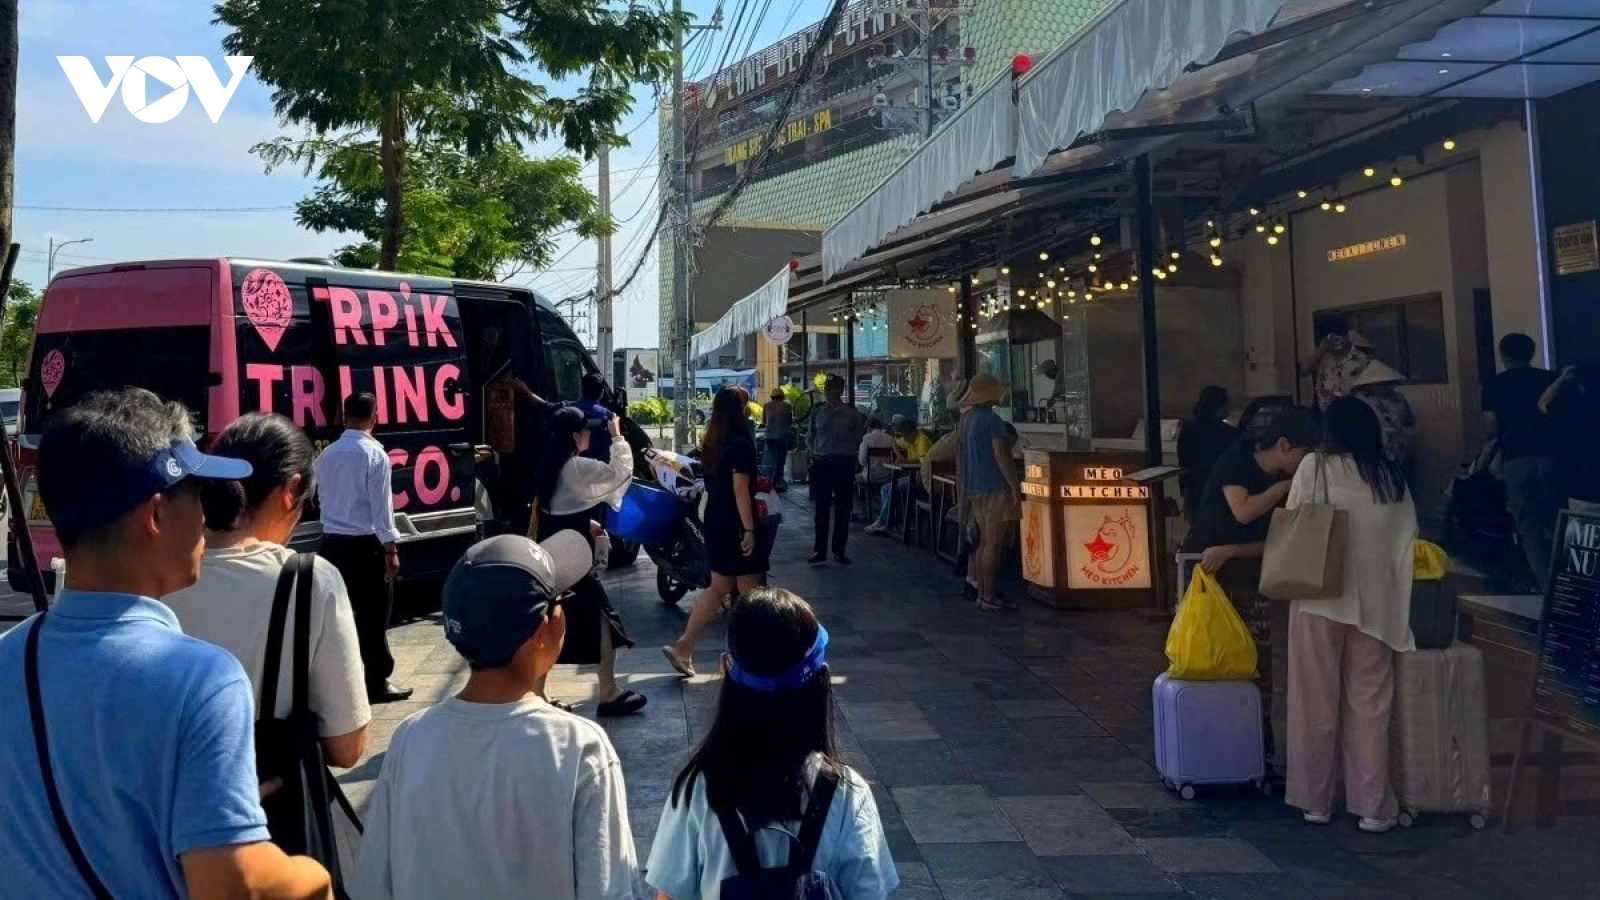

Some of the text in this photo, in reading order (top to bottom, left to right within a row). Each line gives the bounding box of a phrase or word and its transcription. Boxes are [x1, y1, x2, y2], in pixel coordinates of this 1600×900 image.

[814, 108, 832, 133] SPA
[388, 445, 461, 510] CO.
[1086, 468, 1121, 479] MEO
[1062, 486, 1147, 497] KITCHEN
[1566, 547, 1598, 576] NU
[1081, 564, 1139, 585] MEO KITCHEN
